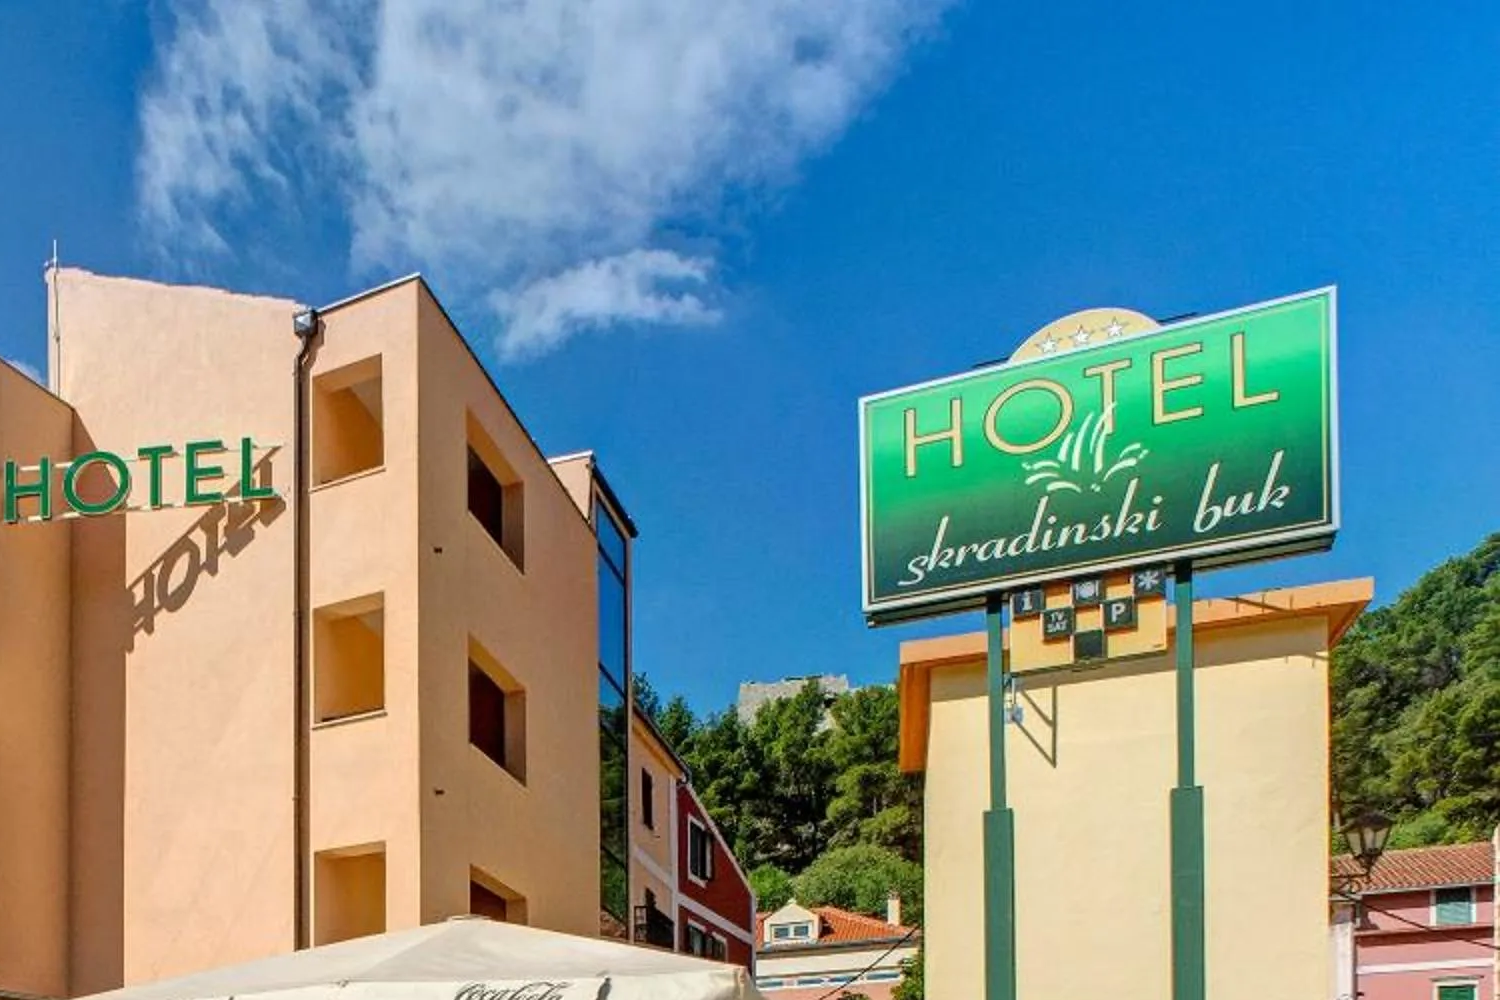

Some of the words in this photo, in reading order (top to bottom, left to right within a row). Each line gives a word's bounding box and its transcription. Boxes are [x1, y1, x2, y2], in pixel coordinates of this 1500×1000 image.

[903, 331, 1281, 478] HOTEL
[3, 437, 278, 523] HOTEL
[897, 477, 1164, 587] skradinski
[1192, 450, 1291, 533] buk
[1046, 621, 1067, 633] SAT
[1050, 611, 1064, 621] TV
[1110, 603, 1126, 622] P
